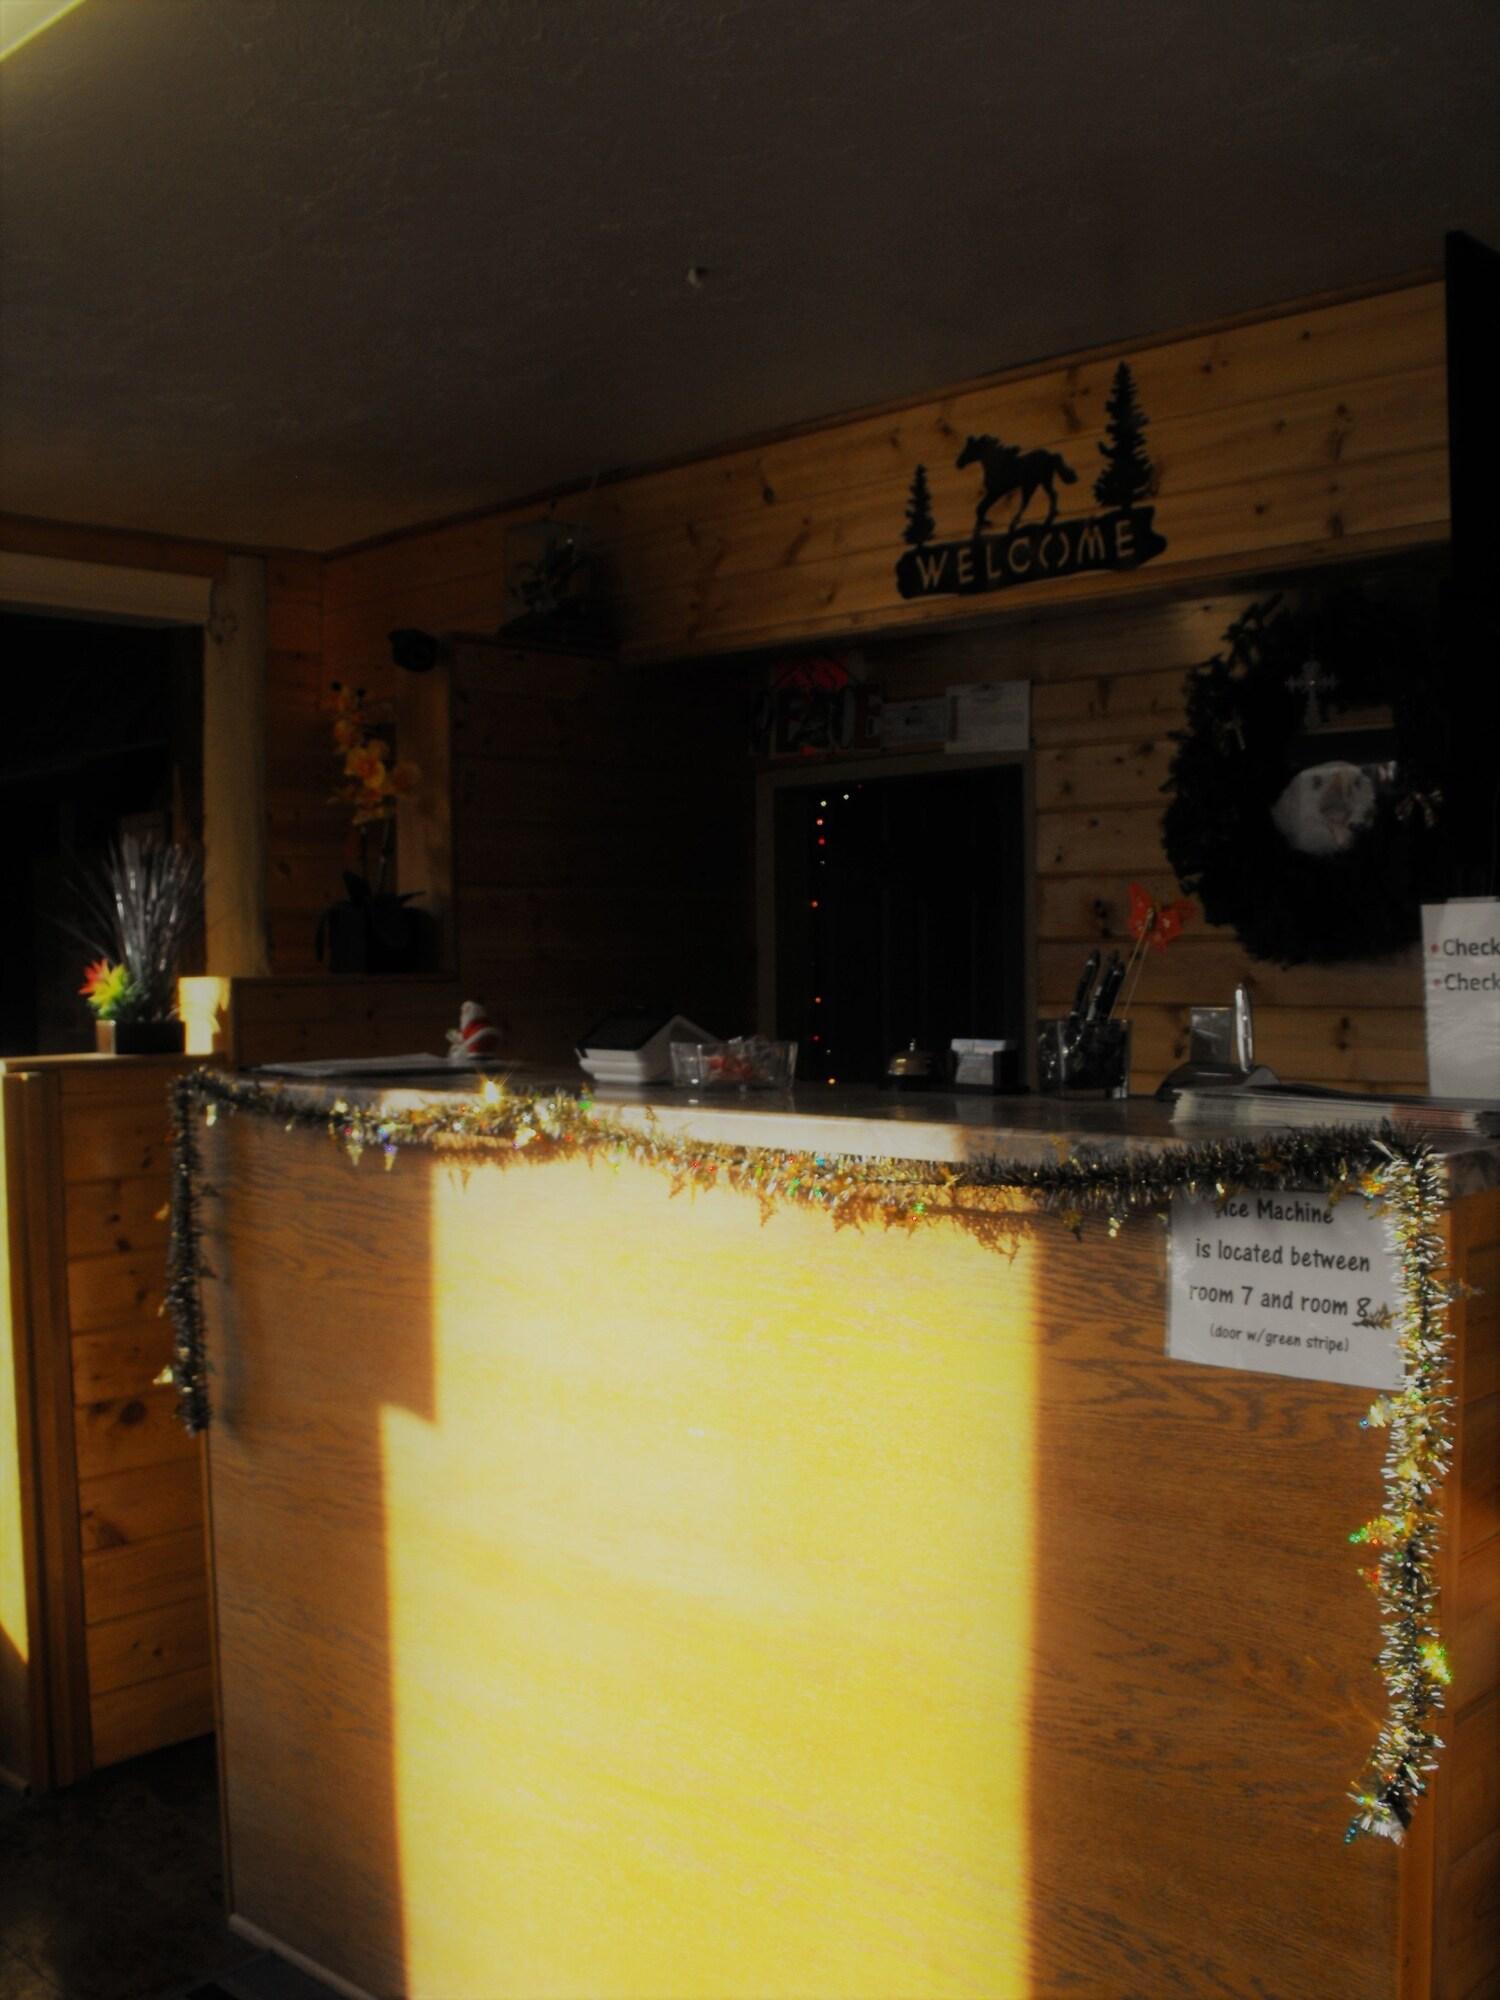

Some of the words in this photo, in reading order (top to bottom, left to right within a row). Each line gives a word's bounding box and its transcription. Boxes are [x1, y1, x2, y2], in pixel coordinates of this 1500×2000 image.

[914, 518, 1136, 590] WELCOME
[1257, 1198, 1334, 1225] Machine
[1196, 1238, 1211, 1258] is
[1218, 1240, 1283, 1265] located
[1291, 1245, 1370, 1272] between
[1189, 1285, 1234, 1305] room
[1242, 1286, 1253, 1306] 7
[1261, 1290, 1293, 1311] and
[1301, 1292, 1348, 1316] room
[1356, 1297, 1371, 1318] 8
[1210, 1323, 1242, 1340] (door
[1246, 1328, 1301, 1348] w/green
[1306, 1335, 1350, 1354] stripe)
